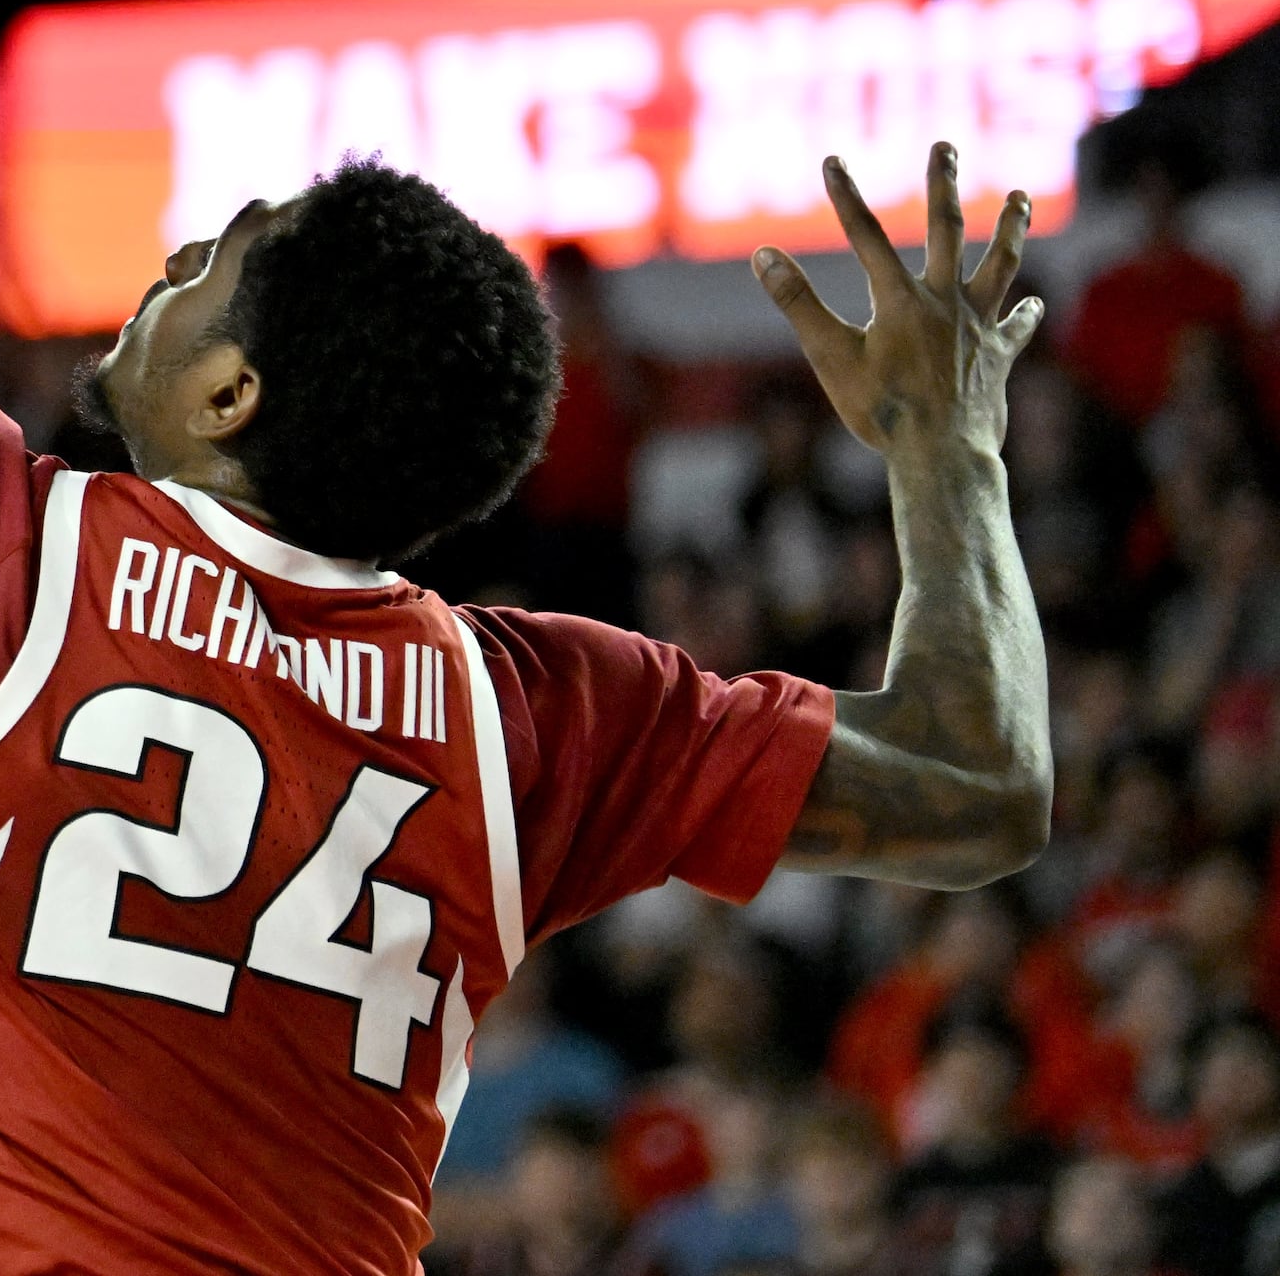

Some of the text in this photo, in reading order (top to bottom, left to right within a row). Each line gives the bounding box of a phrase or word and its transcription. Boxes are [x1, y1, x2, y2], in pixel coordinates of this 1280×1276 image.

[166, 21, 659, 244] MAKE
[402, 642, 446, 743] III
[19, 682, 441, 1092] 24
